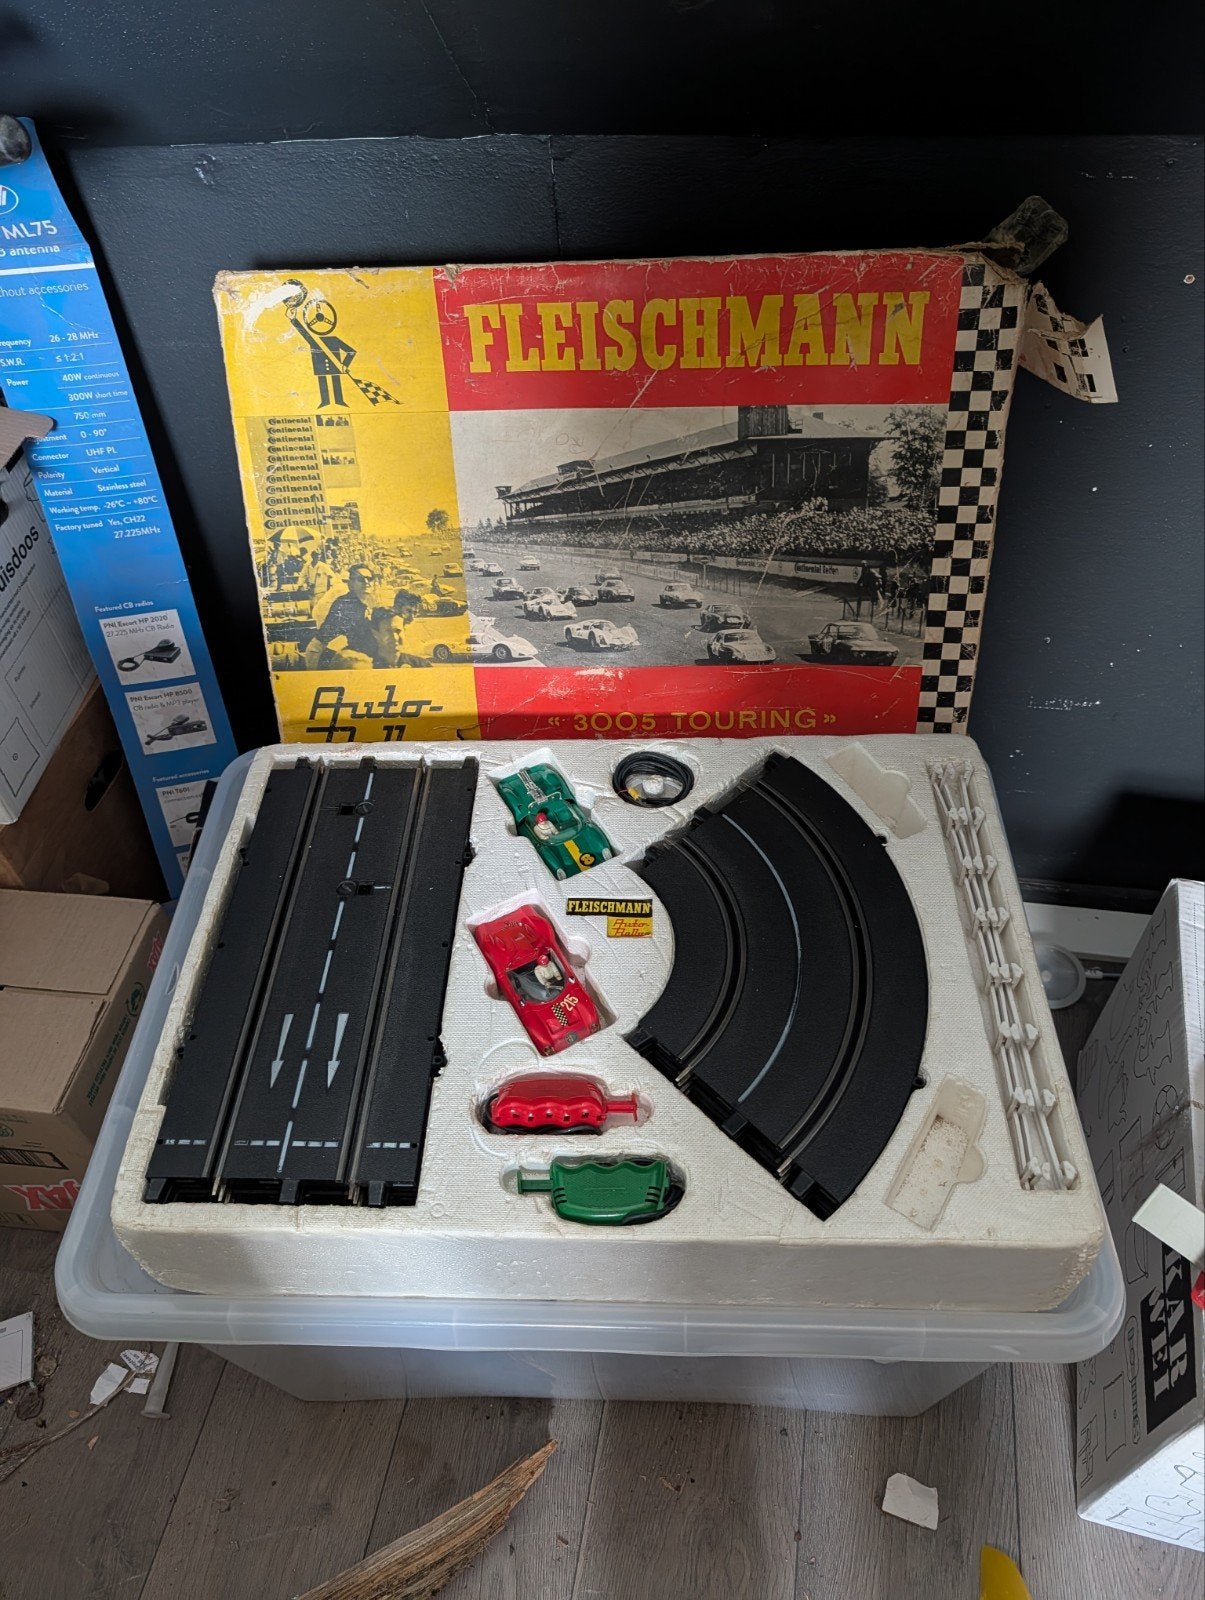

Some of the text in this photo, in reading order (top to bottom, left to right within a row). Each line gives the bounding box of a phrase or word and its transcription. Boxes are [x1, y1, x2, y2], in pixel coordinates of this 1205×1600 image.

[1, 220, 57, 240] ML75
[10, 245, 60, 256] antenna
[29, 282, 89, 296] accessories
[67, 333, 78, 341] 28
[80, 332, 99, 340] MHz
[464, 291, 930, 373] FLEISCHMANN
[62, 374, 82, 382] 40W
[84, 372, 119, 380] continuous
[68, 392, 93, 402] 300W
[74, 412, 88, 420] 750
[80, 430, 87, 439] 0
[32, 446, 118, 461] Connector UHF PL
[38, 464, 120, 480] Polarity Vertical
[44, 479, 147, 497] Material Stainless steel
[49, 507, 79, 515] Working
[79, 503, 101, 513] temp.
[55, 514, 147, 532] Factory tuned Yes, CH22
[94, 604, 122, 613] Featured
[122, 601, 134, 609] CB
[118, 618, 138, 627] Escort
[150, 614, 168, 622] 2020
[156, 622, 175, 630] Radio
[308, 684, 443, 728] Auto-
[573, 712, 656, 732] 3005
[670, 708, 816, 731] TOURING
[567, 900, 651, 914] FLEISCHMANN
[561, 994, 579, 1012] 215
